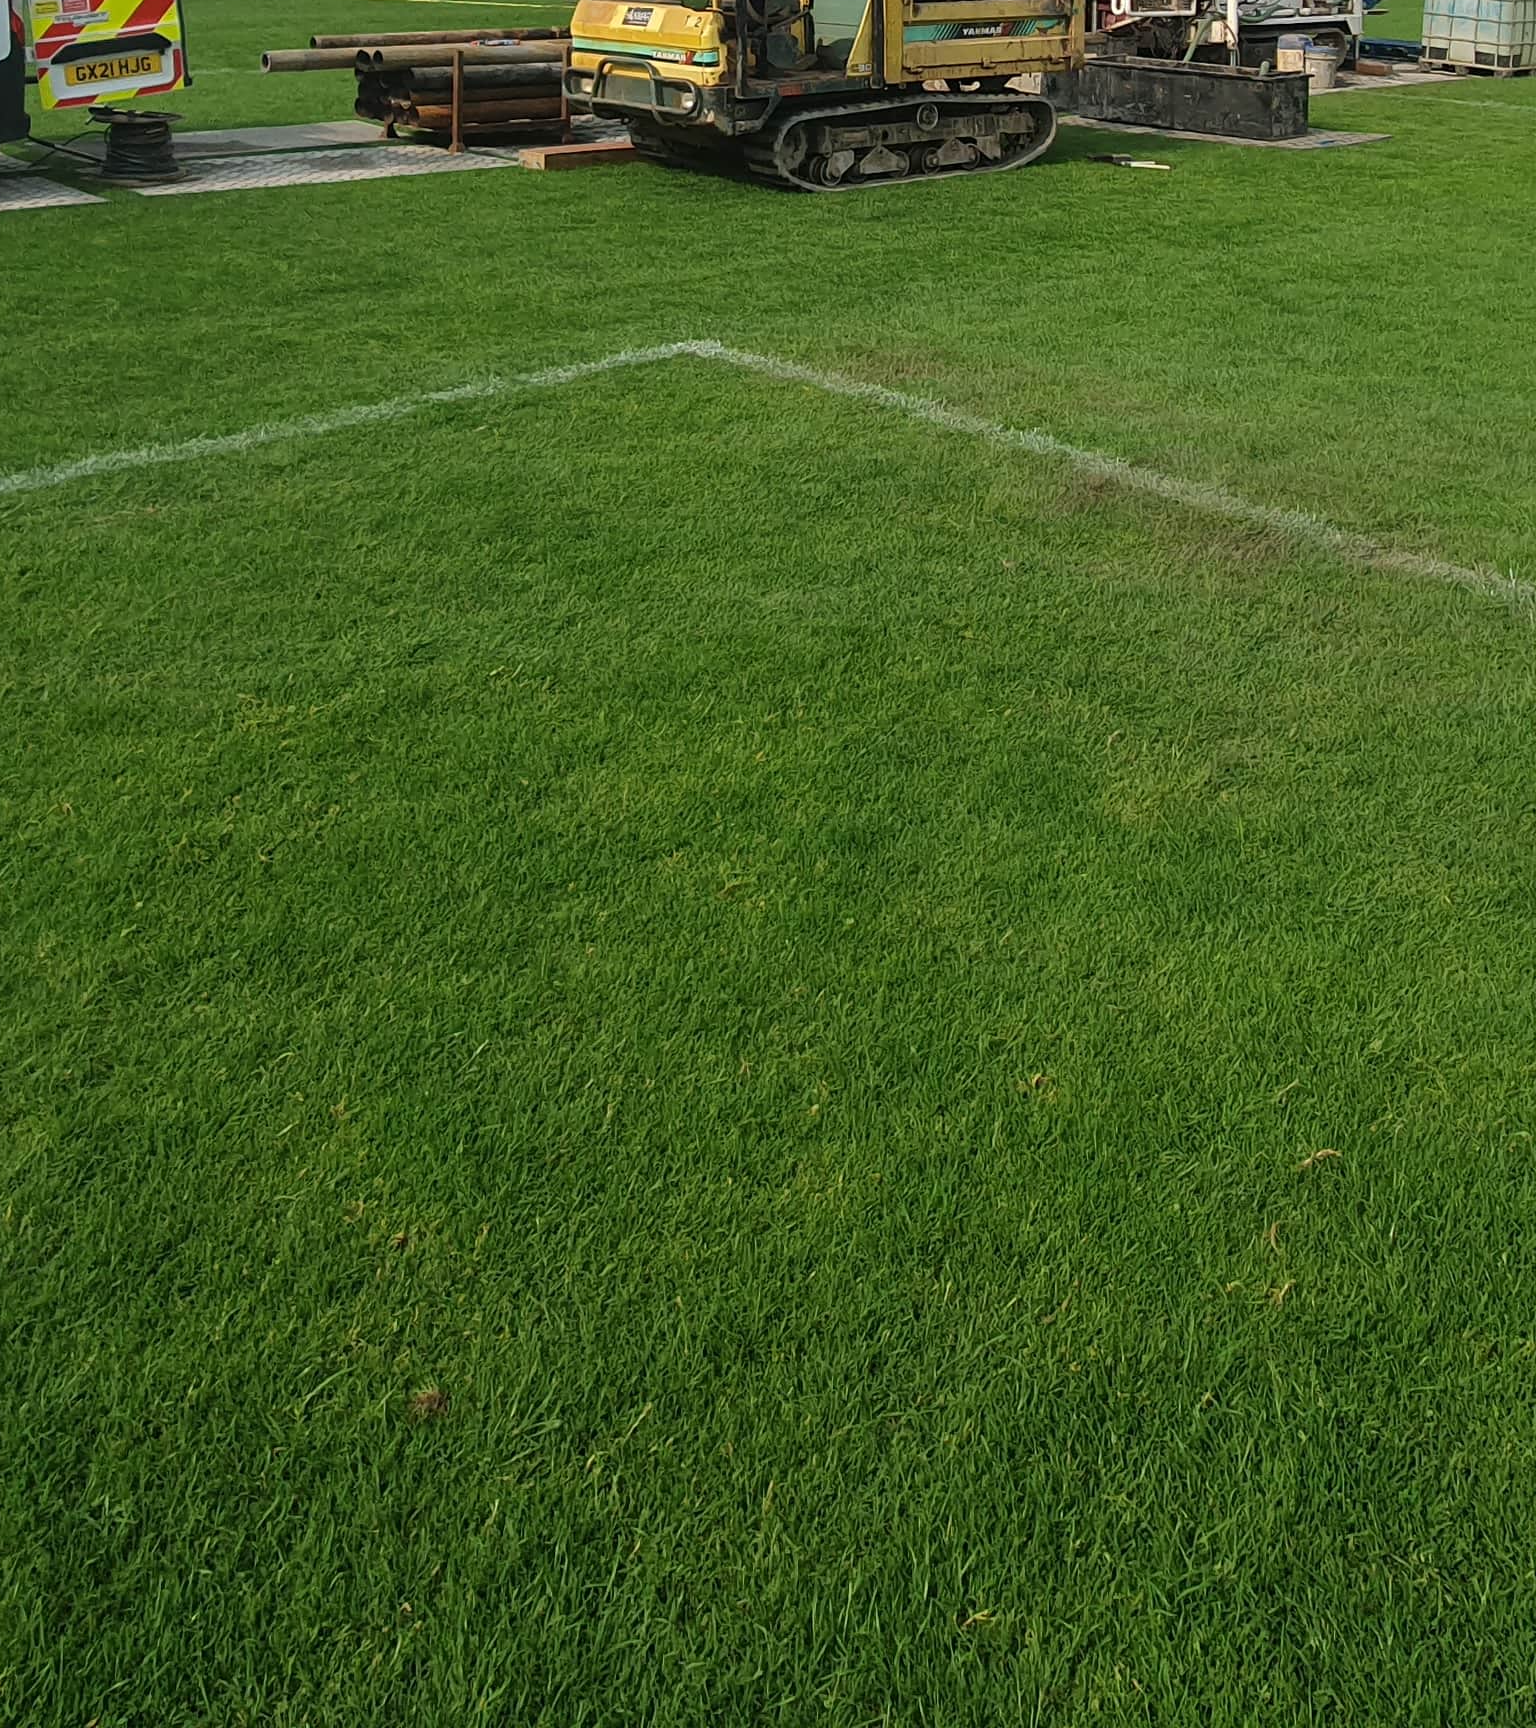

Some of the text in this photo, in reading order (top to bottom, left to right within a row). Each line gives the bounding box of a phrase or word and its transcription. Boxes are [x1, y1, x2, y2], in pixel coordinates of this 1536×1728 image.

[963, 24, 1003, 36] YANMAR
[75, 56, 152, 82] GX21 HJG
